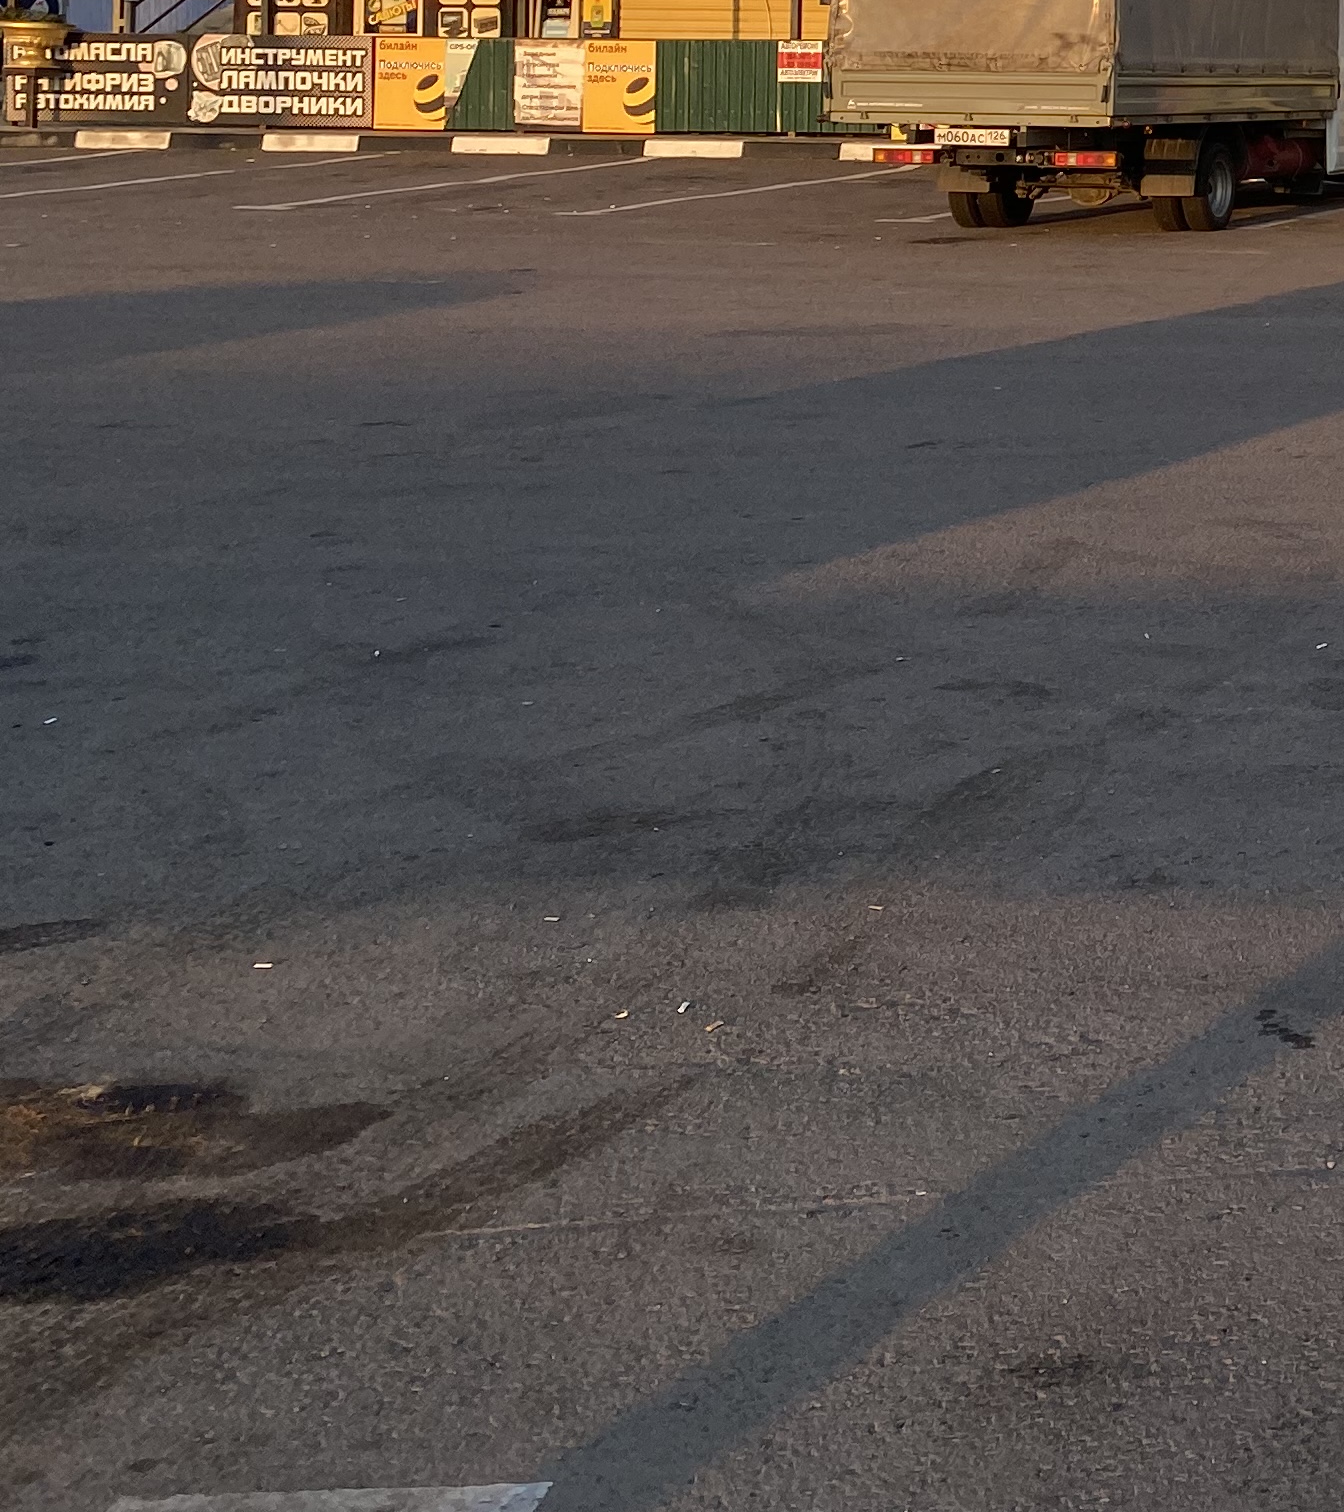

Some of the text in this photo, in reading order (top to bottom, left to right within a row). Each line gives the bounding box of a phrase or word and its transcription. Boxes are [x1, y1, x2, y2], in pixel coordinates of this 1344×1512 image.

[12, 41, 153, 62] АОМАСЛА
[379, 40, 417, 51] билайн
[588, 43, 627, 54] билайн
[221, 48, 366, 67] ИНСТРУМЕНТ
[379, 59, 442, 71] Подключись
[587, 62, 652, 74] Подключись
[219, 71, 364, 92] ЛАМПОЧКИ
[378, 72, 407, 81] здесь
[587, 75, 617, 84] здесь
[14, 93, 155, 111] АВТОХИМИЯ
[219, 95, 364, 116] ДВОРНИКИ
[936, 131, 1006, 144] М060АС 126
